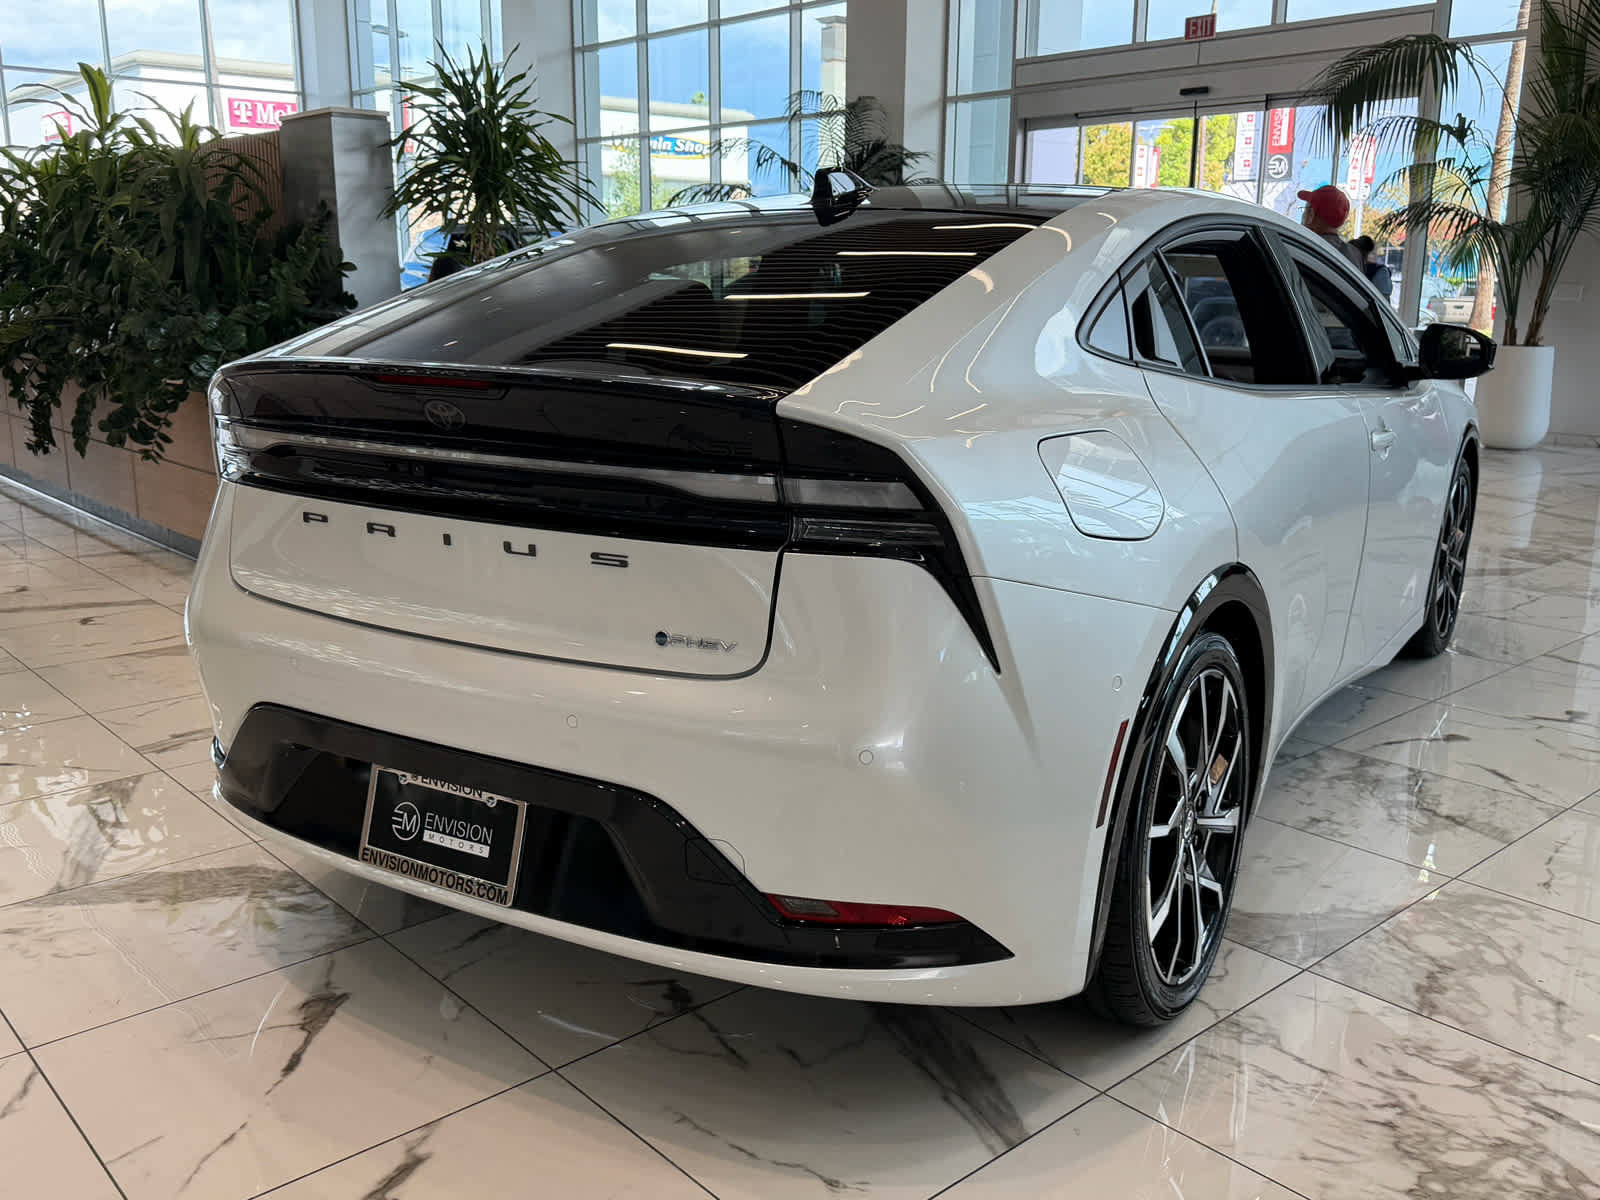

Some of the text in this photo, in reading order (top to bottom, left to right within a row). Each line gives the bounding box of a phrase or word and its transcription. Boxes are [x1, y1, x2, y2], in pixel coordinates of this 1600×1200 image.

[1190, 17, 1212, 37] EXIT
[303, 511, 629, 568] PRIUS
[421, 776, 483, 799] ENVISION
[424, 812, 493, 844] ENVISION
[428, 833, 485, 854] MOTORS
[361, 848, 509, 905] ENVISIONMOTORS.COM
